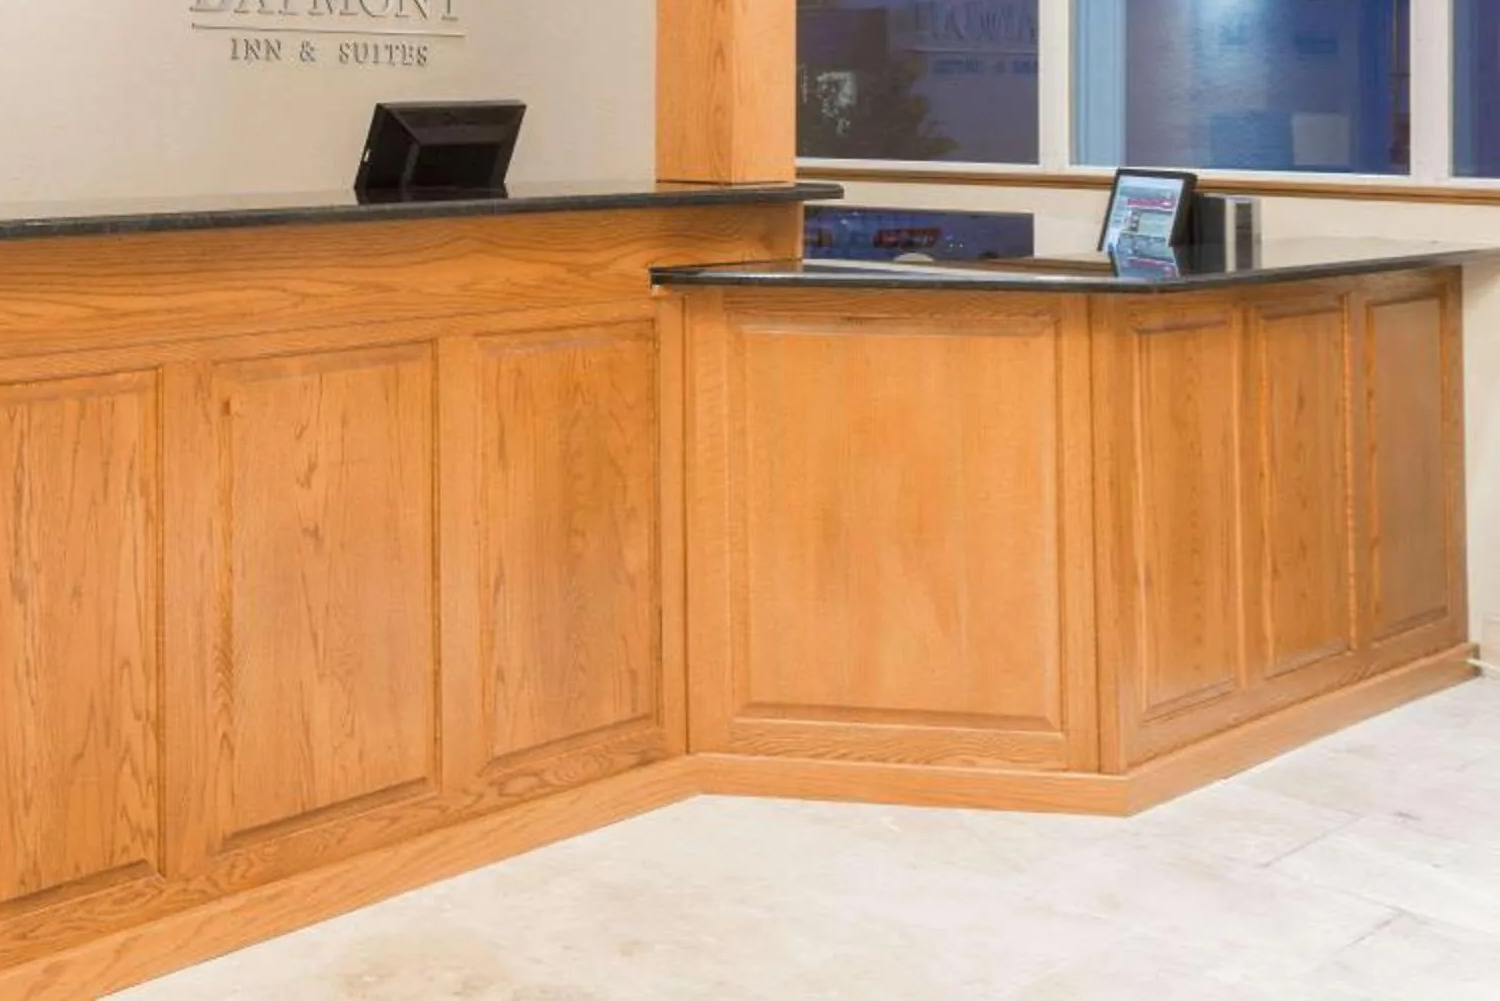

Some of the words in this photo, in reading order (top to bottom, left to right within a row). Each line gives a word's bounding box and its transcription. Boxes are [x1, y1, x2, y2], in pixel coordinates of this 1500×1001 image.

[230, 37, 283, 62] INN
[300, 40, 316, 63] &
[338, 42, 429, 66] SUITES
